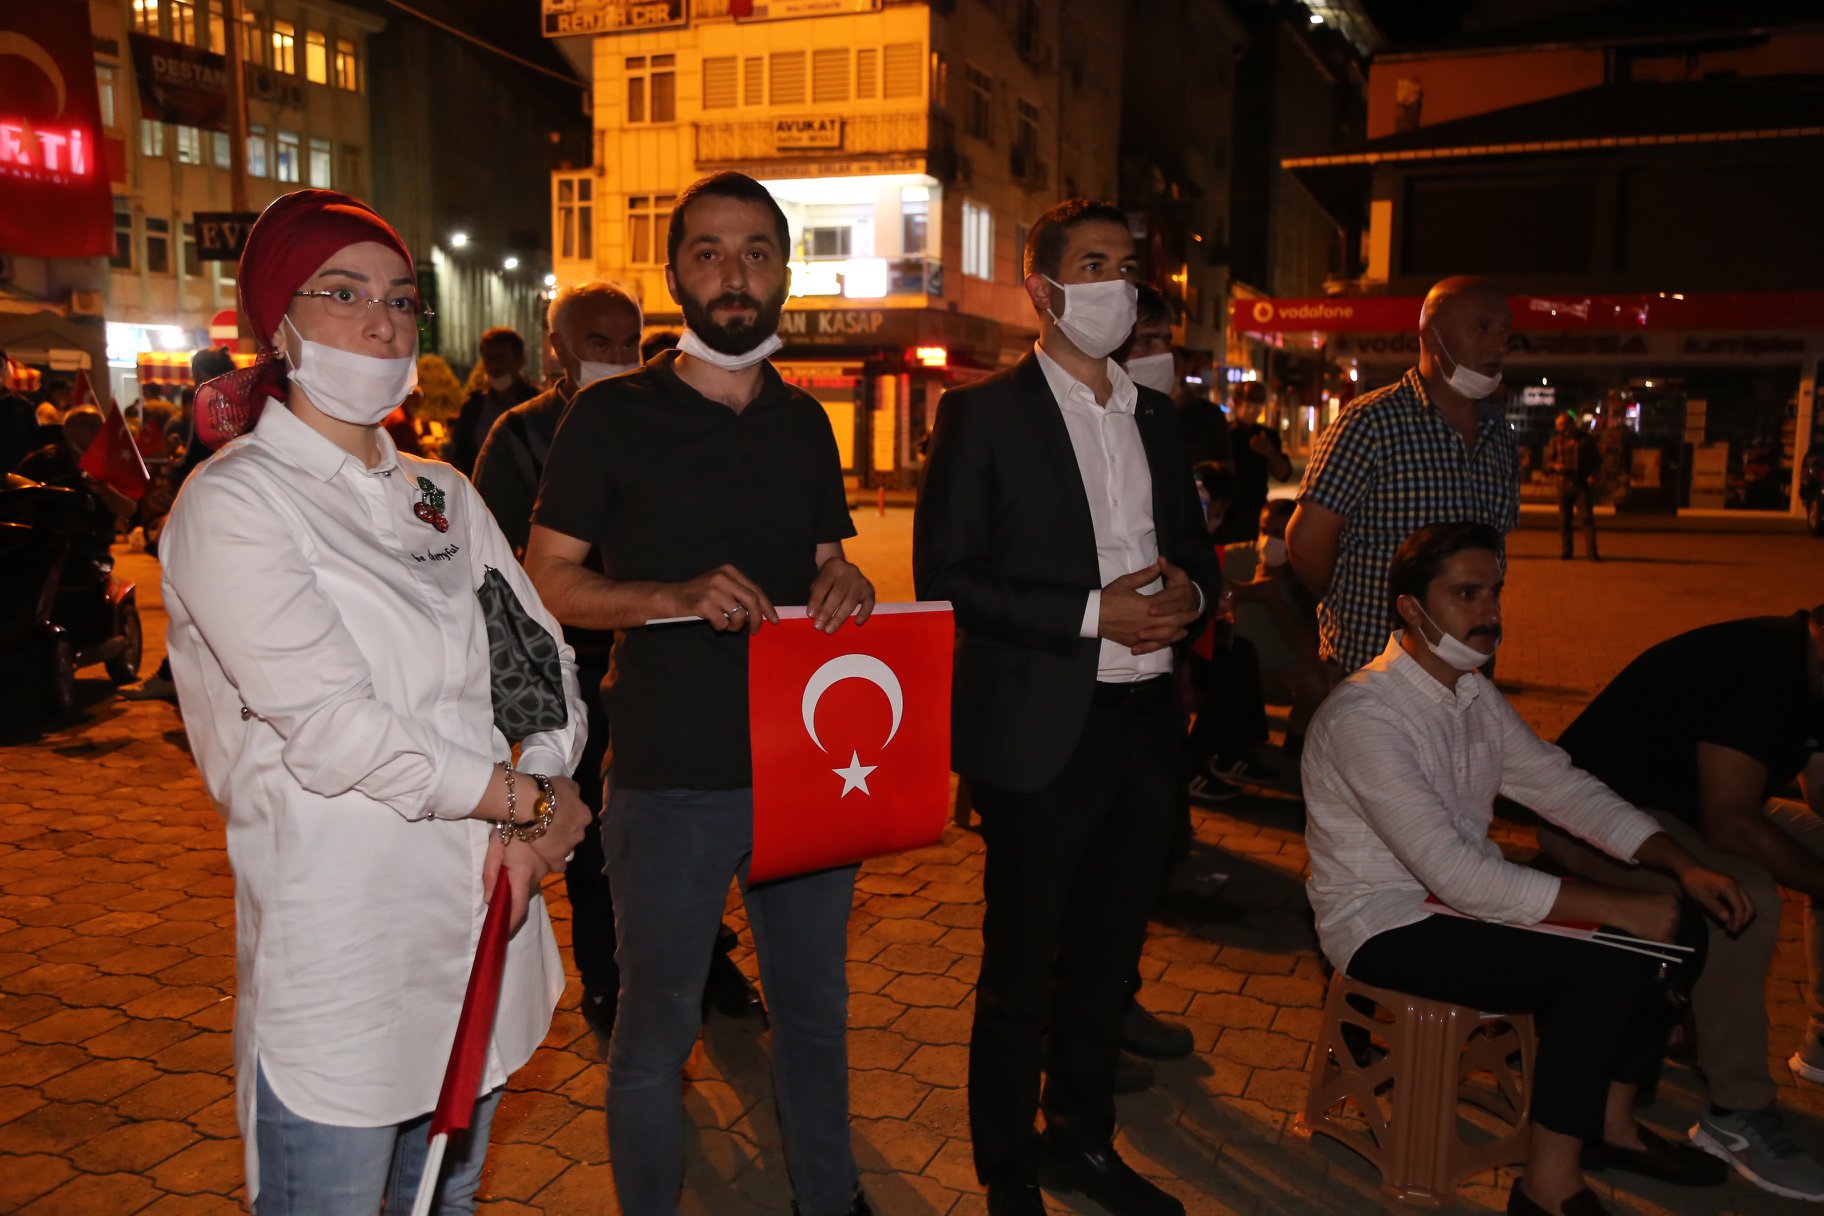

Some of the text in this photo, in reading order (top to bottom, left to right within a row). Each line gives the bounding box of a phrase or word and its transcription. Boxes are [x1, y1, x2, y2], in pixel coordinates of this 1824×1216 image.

[558, 11, 607, 32] RENT
[632, 4, 670, 25] CAR
[152, 55, 226, 87] DESTAN
[776, 120, 835, 132] AVUKAT
[202, 222, 242, 250] EV
[1279, 303, 1354, 319] vodafone
[781, 312, 884, 334] AN KASAP
[1356, 332, 1420, 353] voda
